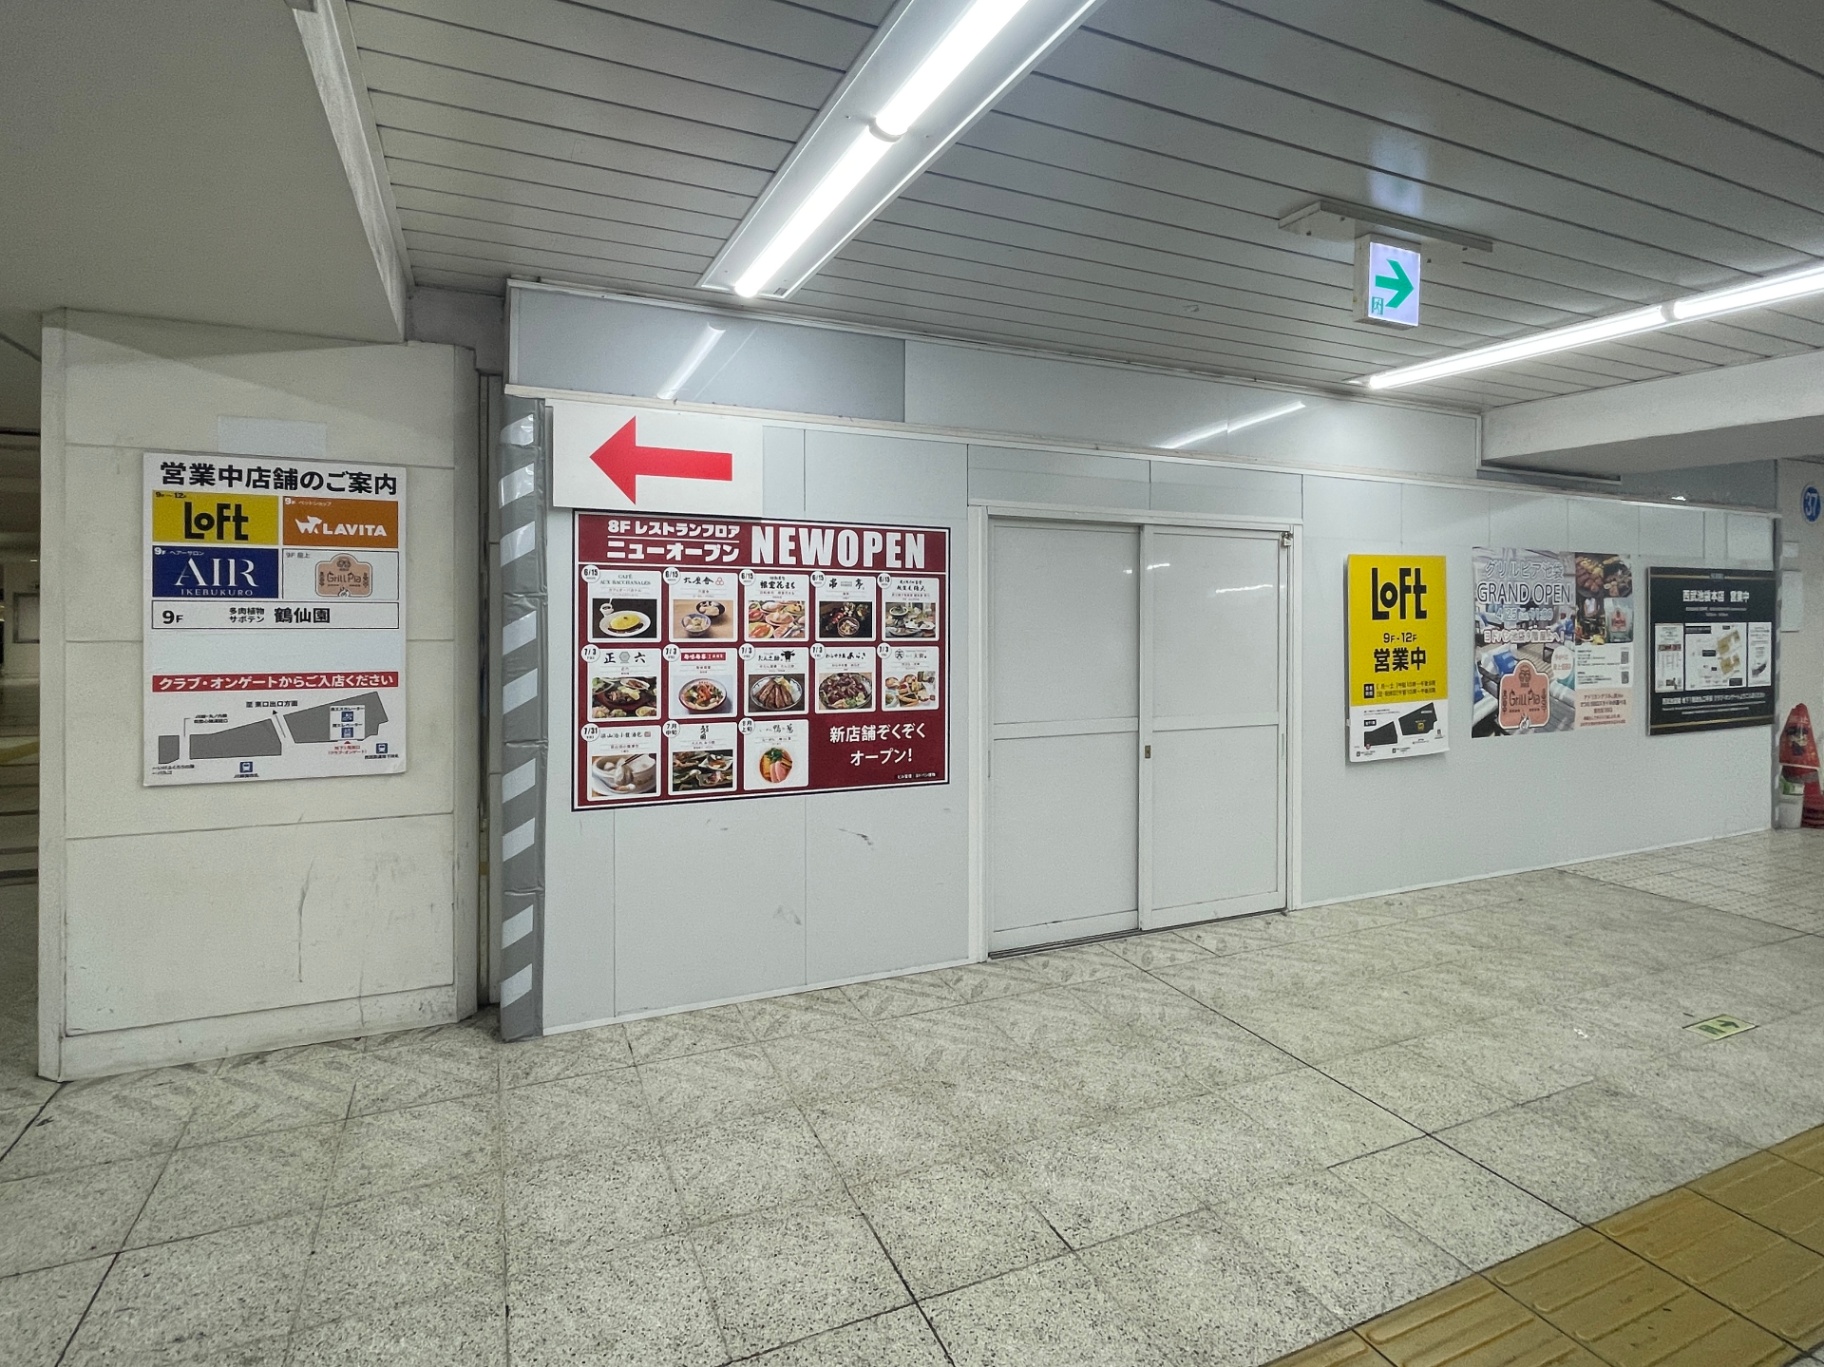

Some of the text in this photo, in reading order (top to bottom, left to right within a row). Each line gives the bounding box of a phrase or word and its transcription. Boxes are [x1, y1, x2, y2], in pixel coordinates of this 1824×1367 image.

[160, 461, 397, 496] 営業中店舗のご案内
[322, 523, 388, 537] LAVITA
[607, 519, 741, 538] 8F レストランフロア
[154, 547, 167, 556] 9F
[606, 540, 740, 563] ニューオープン
[751, 525, 926, 569] NEWOPEN
[174, 557, 259, 587] AIR
[326, 570, 346, 583] Grill
[583, 568, 598, 576] 6/15
[665, 570, 678, 578] 6/15
[740, 572, 754, 580] 6/15
[1485, 560, 1564, 580] グリルピア池袋
[181, 588, 254, 597] IKEBUKURO
[1477, 582, 1571, 605] GRAND OPEN
[162, 610, 184, 624] 9F
[229, 607, 265, 615] 多肉植物
[274, 607, 331, 624] 鶴仙園
[229, 615, 265, 623] サボテン
[584, 648, 597, 656] 7/3
[603, 652, 646, 664] 正 六
[665, 647, 677, 655] 7/3
[1373, 646, 1427, 673] 営業中
[158, 674, 394, 690] クラブ・オンゲートからご入店ください
[1509, 689, 1527, 706] Grill
[584, 727, 598, 735] 7/31
[829, 723, 926, 744] 新店舗ぞくぞく
[849, 747, 913, 767] オープン！
